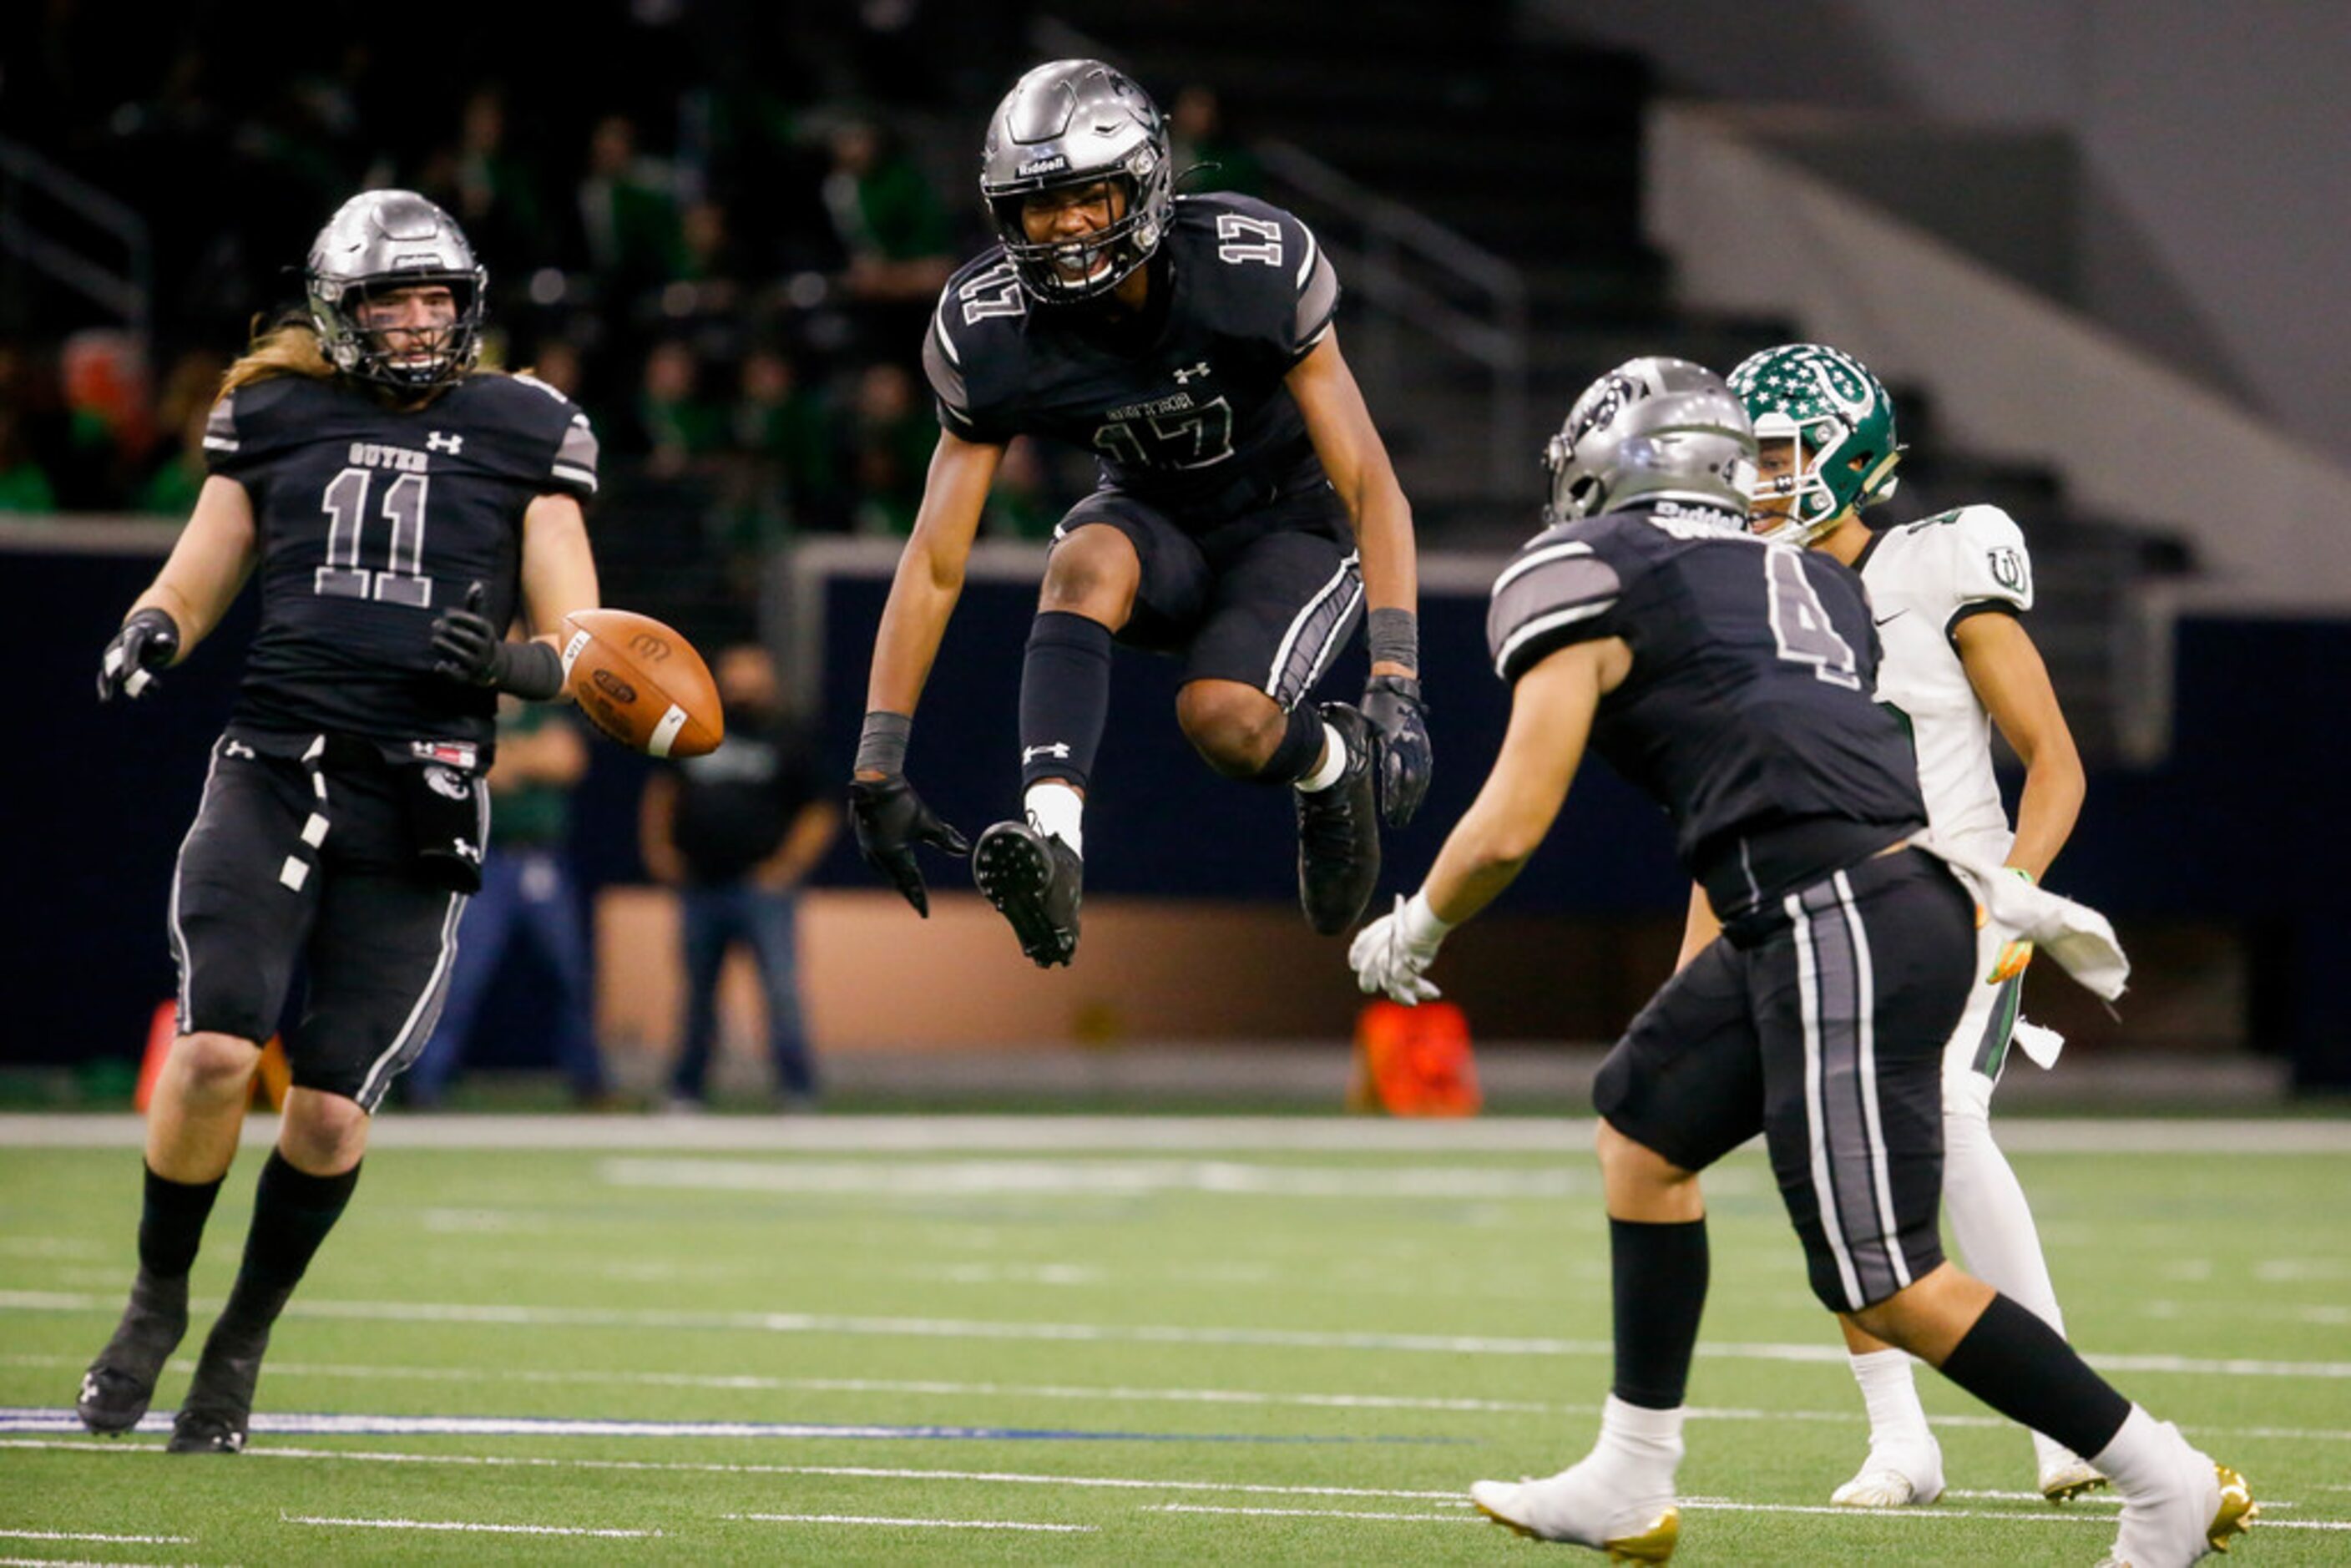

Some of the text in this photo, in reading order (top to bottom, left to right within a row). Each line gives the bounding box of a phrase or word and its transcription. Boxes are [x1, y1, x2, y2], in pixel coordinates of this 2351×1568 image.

[1216, 215, 1282, 267] 17
[959, 263, 1027, 326] 17
[1092, 396, 1236, 470] 17
[314, 467, 432, 609] 11
[1765, 544, 1862, 692] 4
